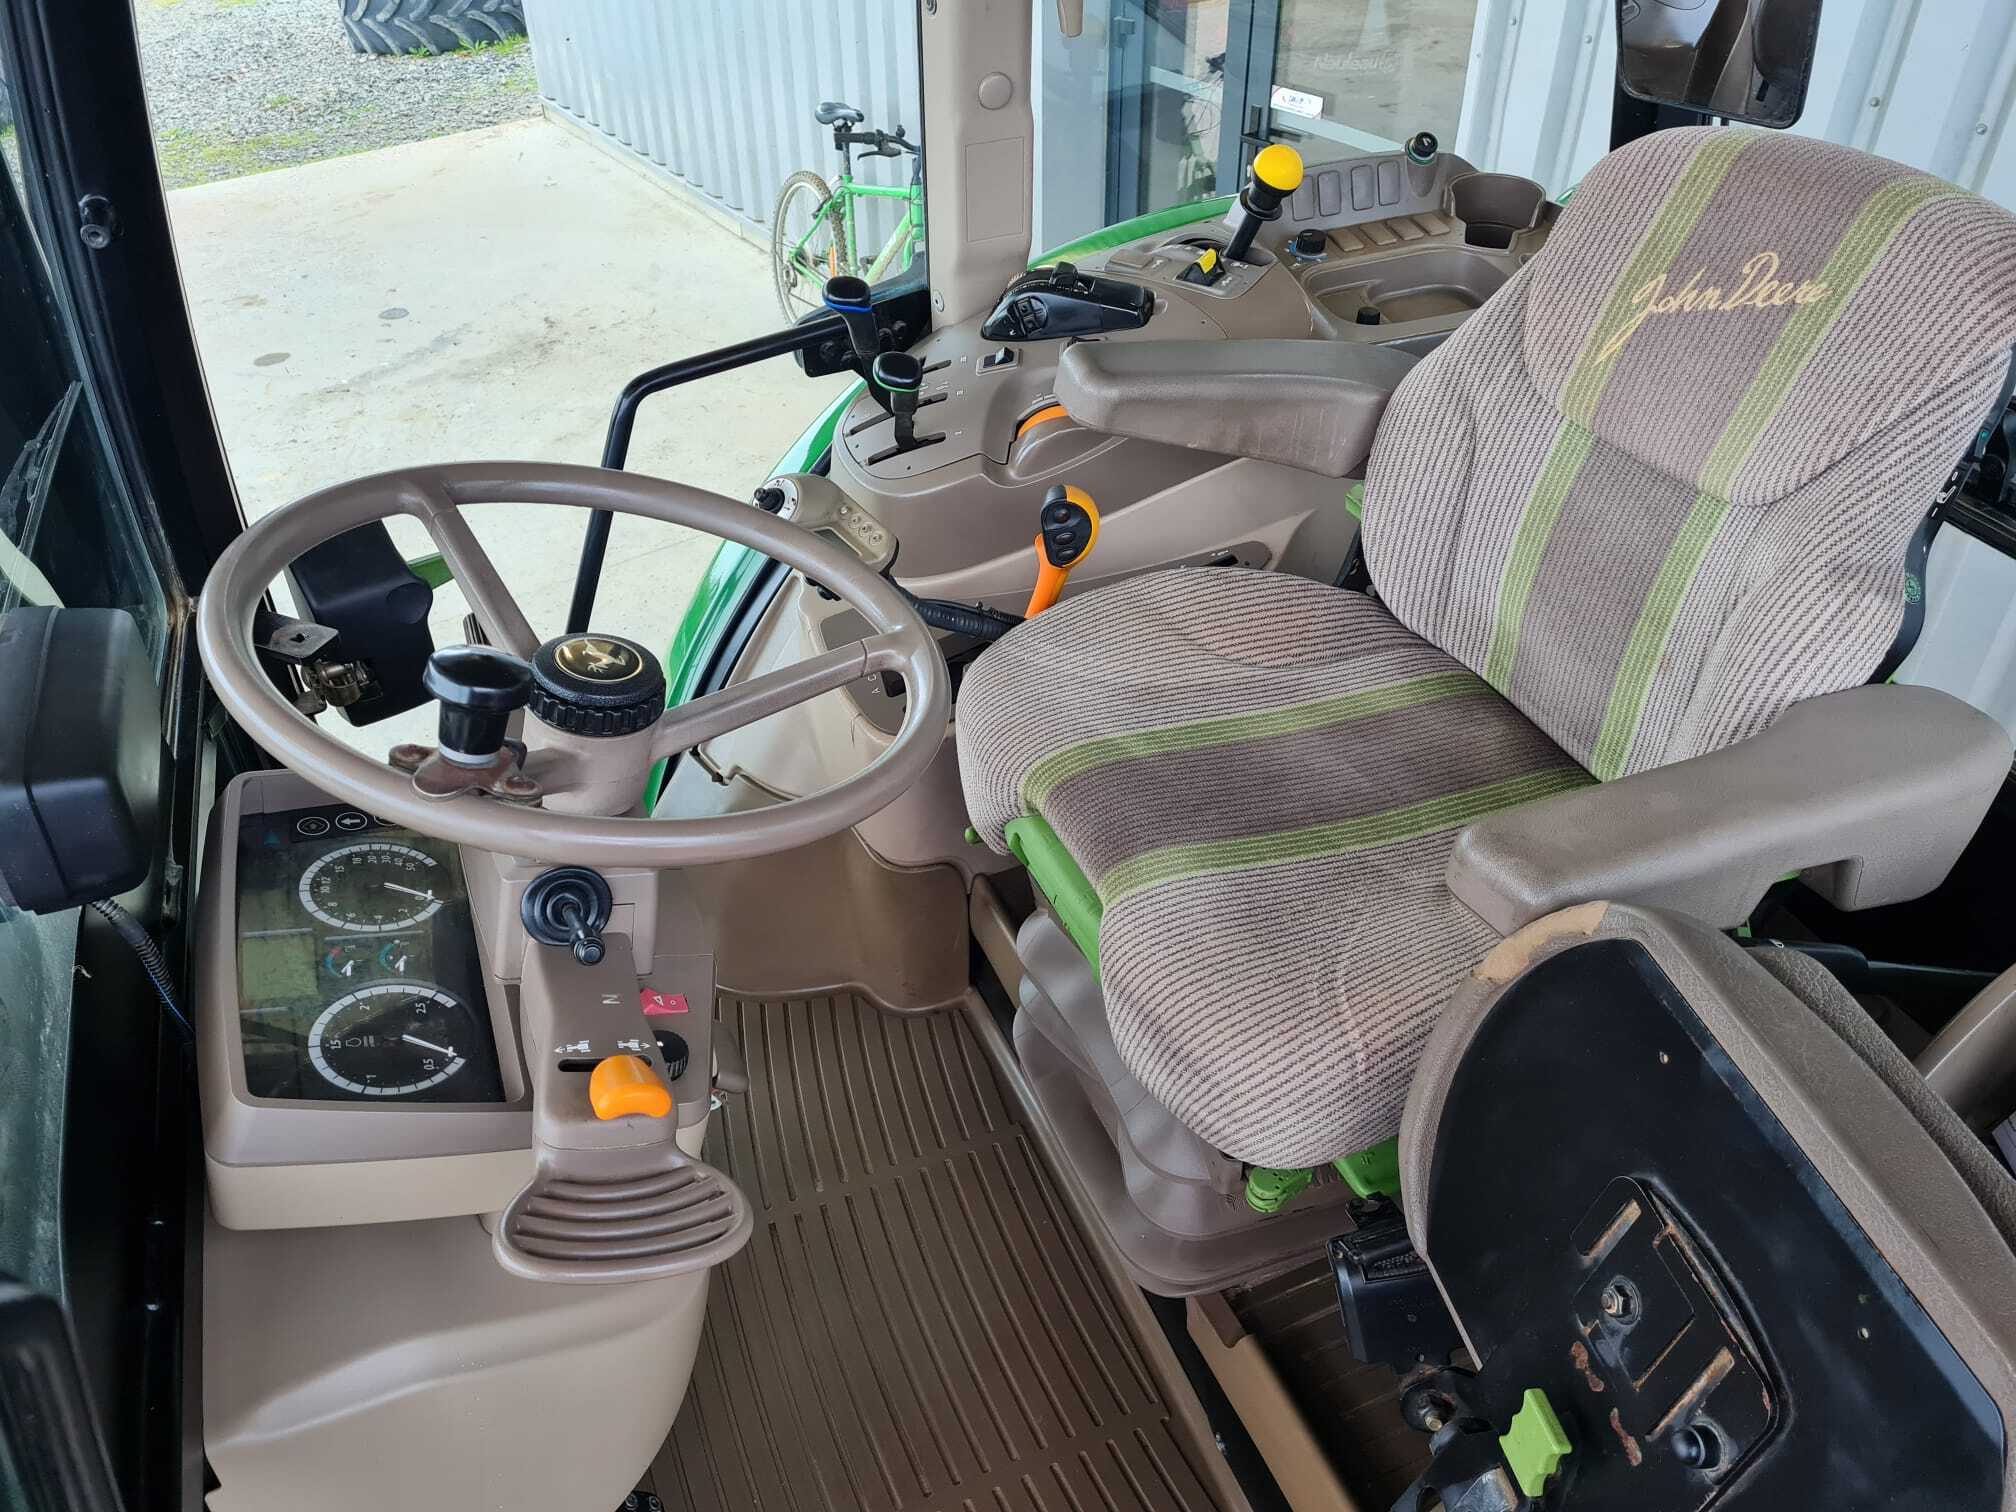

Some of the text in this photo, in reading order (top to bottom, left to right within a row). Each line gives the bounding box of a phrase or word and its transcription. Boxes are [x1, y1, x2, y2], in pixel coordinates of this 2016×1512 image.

[1593, 252, 1834, 366] John Deere
[367, 855, 378, 864] 20
[381, 855, 392, 864] 30
[334, 865, 345, 873] 15
